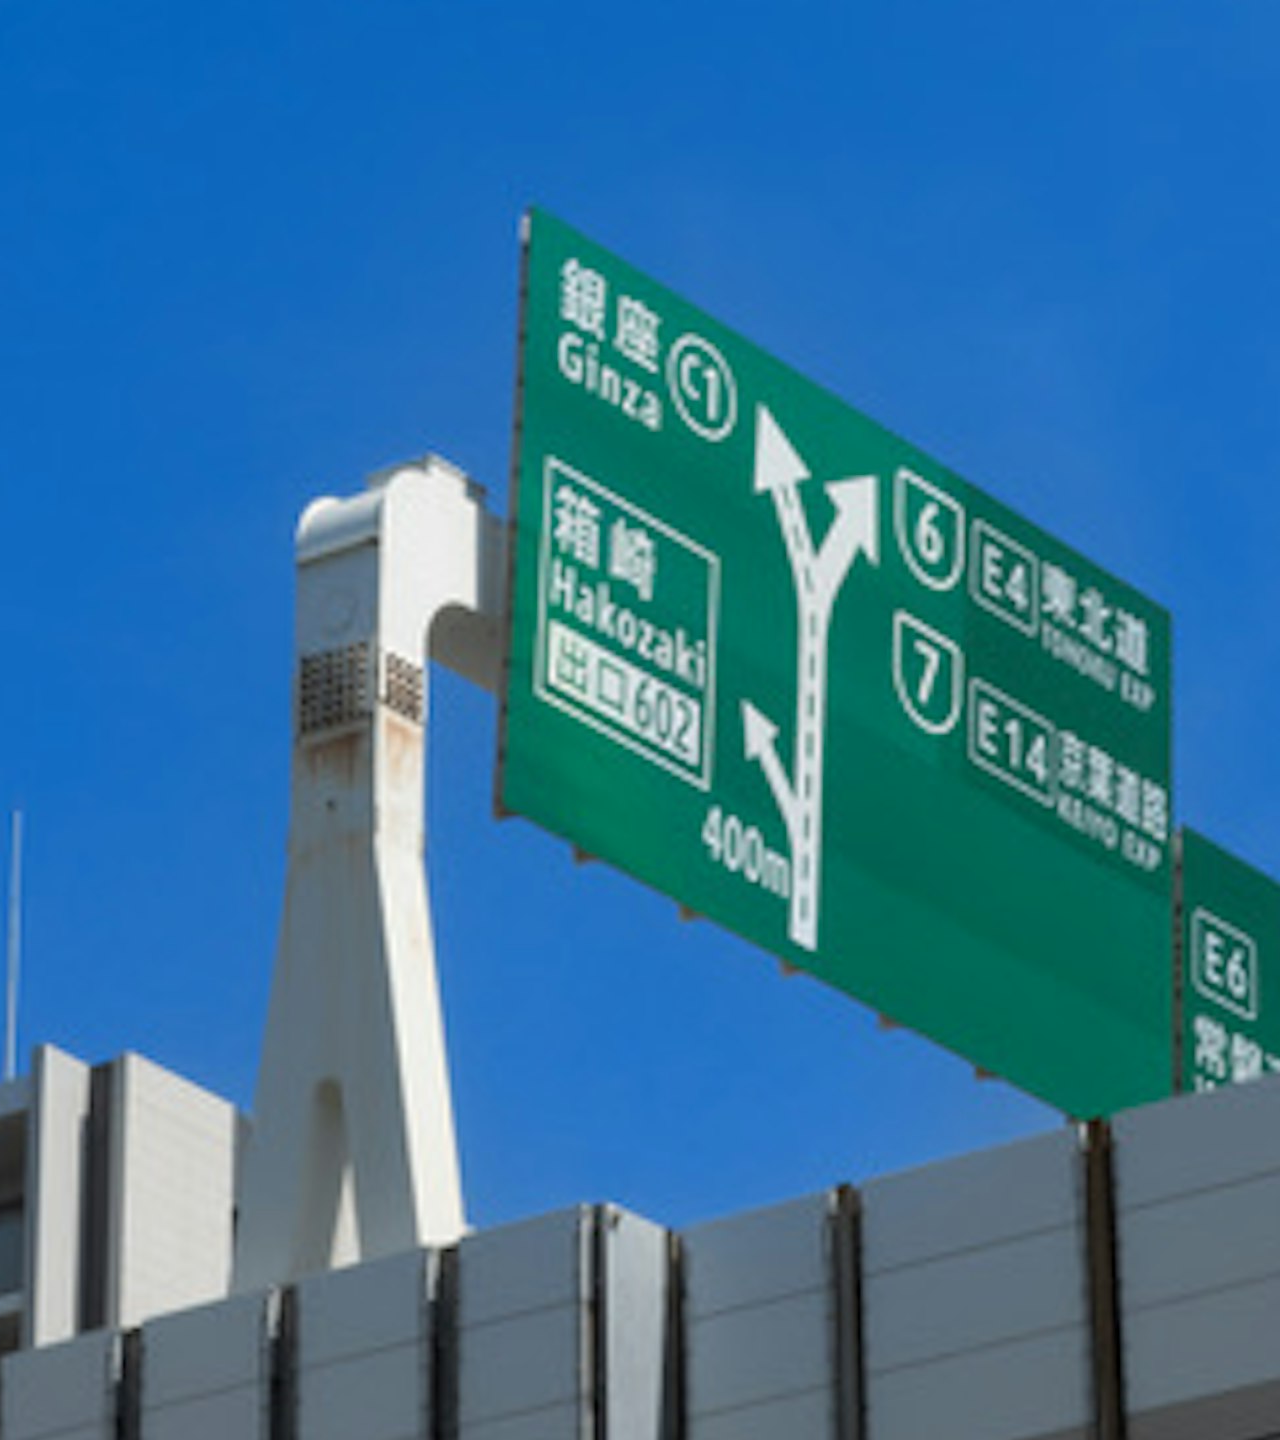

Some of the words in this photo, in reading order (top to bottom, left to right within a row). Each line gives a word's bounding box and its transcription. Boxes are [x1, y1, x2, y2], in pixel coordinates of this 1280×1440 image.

[561, 257, 662, 374] 銀座
[558, 331, 662, 432] Ginza
[680, 352, 720, 422] C1
[554, 485, 655, 602] 箱崎
[914, 502, 946, 564] 6
[982, 541, 1029, 612] E4
[549, 558, 706, 691] Hakozaki
[1041, 560, 1150, 676] 東北道
[914, 639, 942, 704] 7
[978, 698, 1047, 785] E14
[1055, 728, 1170, 843] 京葉道路
[701, 804, 790, 898] 400m
[1204, 931, 1249, 1000] E6
